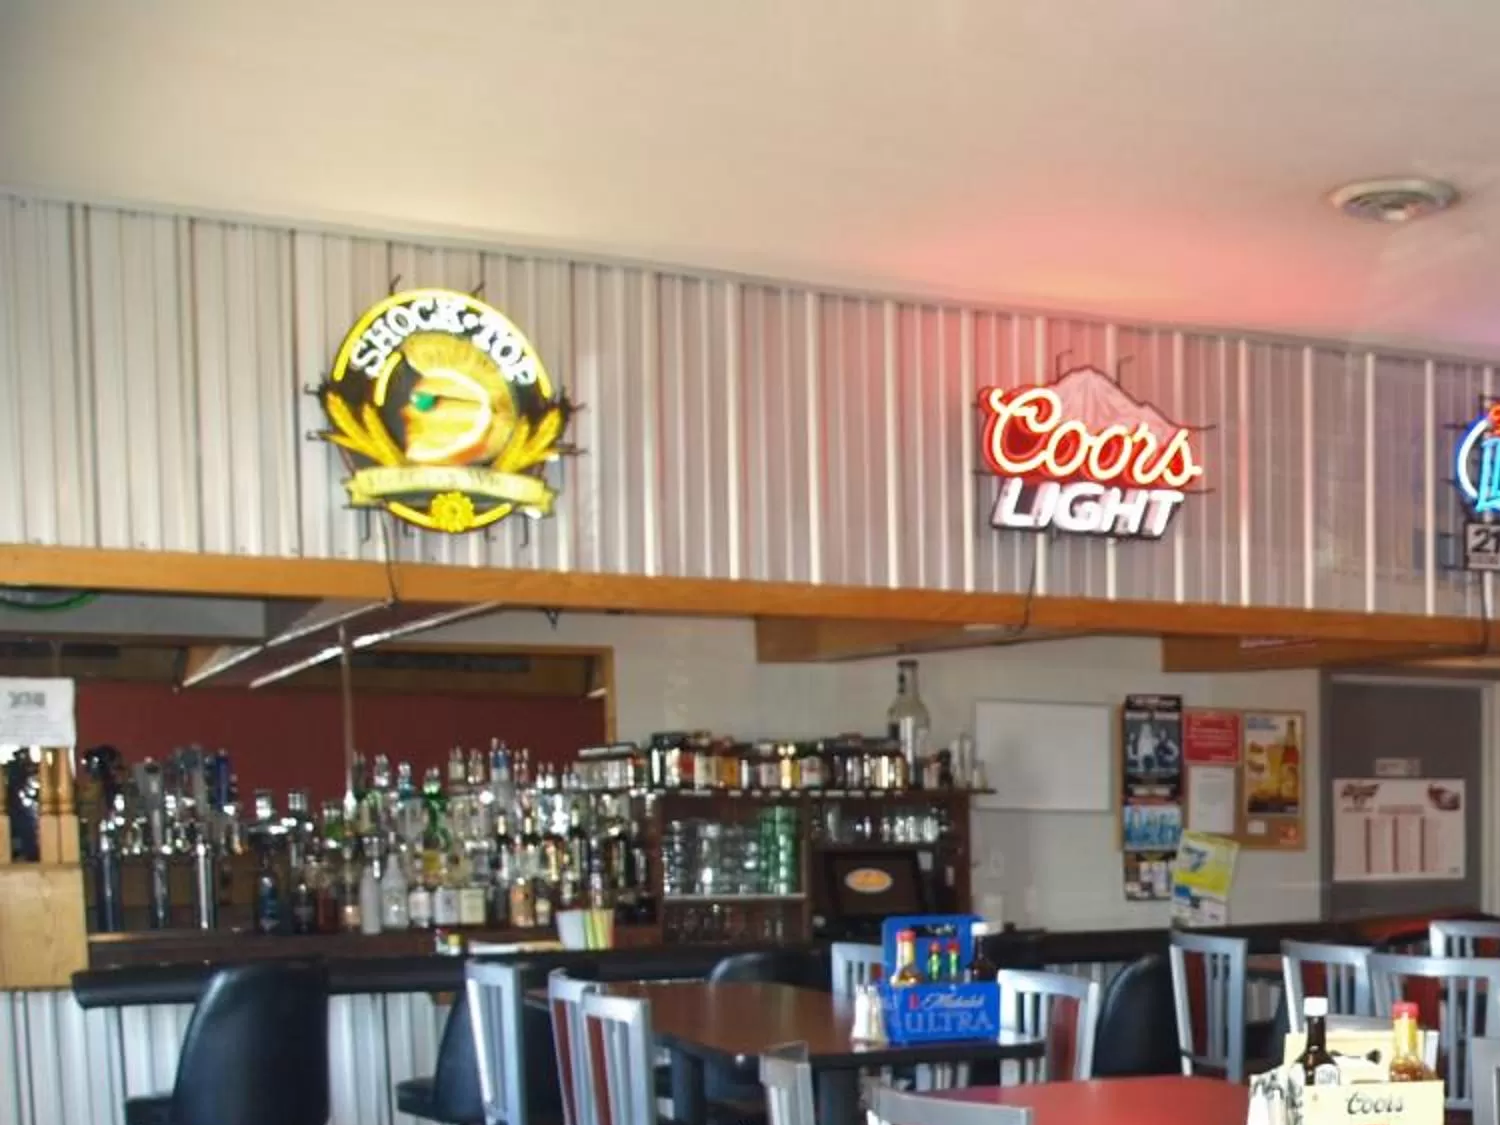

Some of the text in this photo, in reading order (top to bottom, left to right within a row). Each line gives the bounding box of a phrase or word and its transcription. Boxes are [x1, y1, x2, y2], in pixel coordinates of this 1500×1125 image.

[351, 297, 538, 385] SHOCK TOP
[986, 386, 1203, 487] Coors
[993, 477, 1185, 537] LIGHT
[904, 1010, 994, 1033] ULTRA
[1347, 1091, 1404, 1115] Coors
